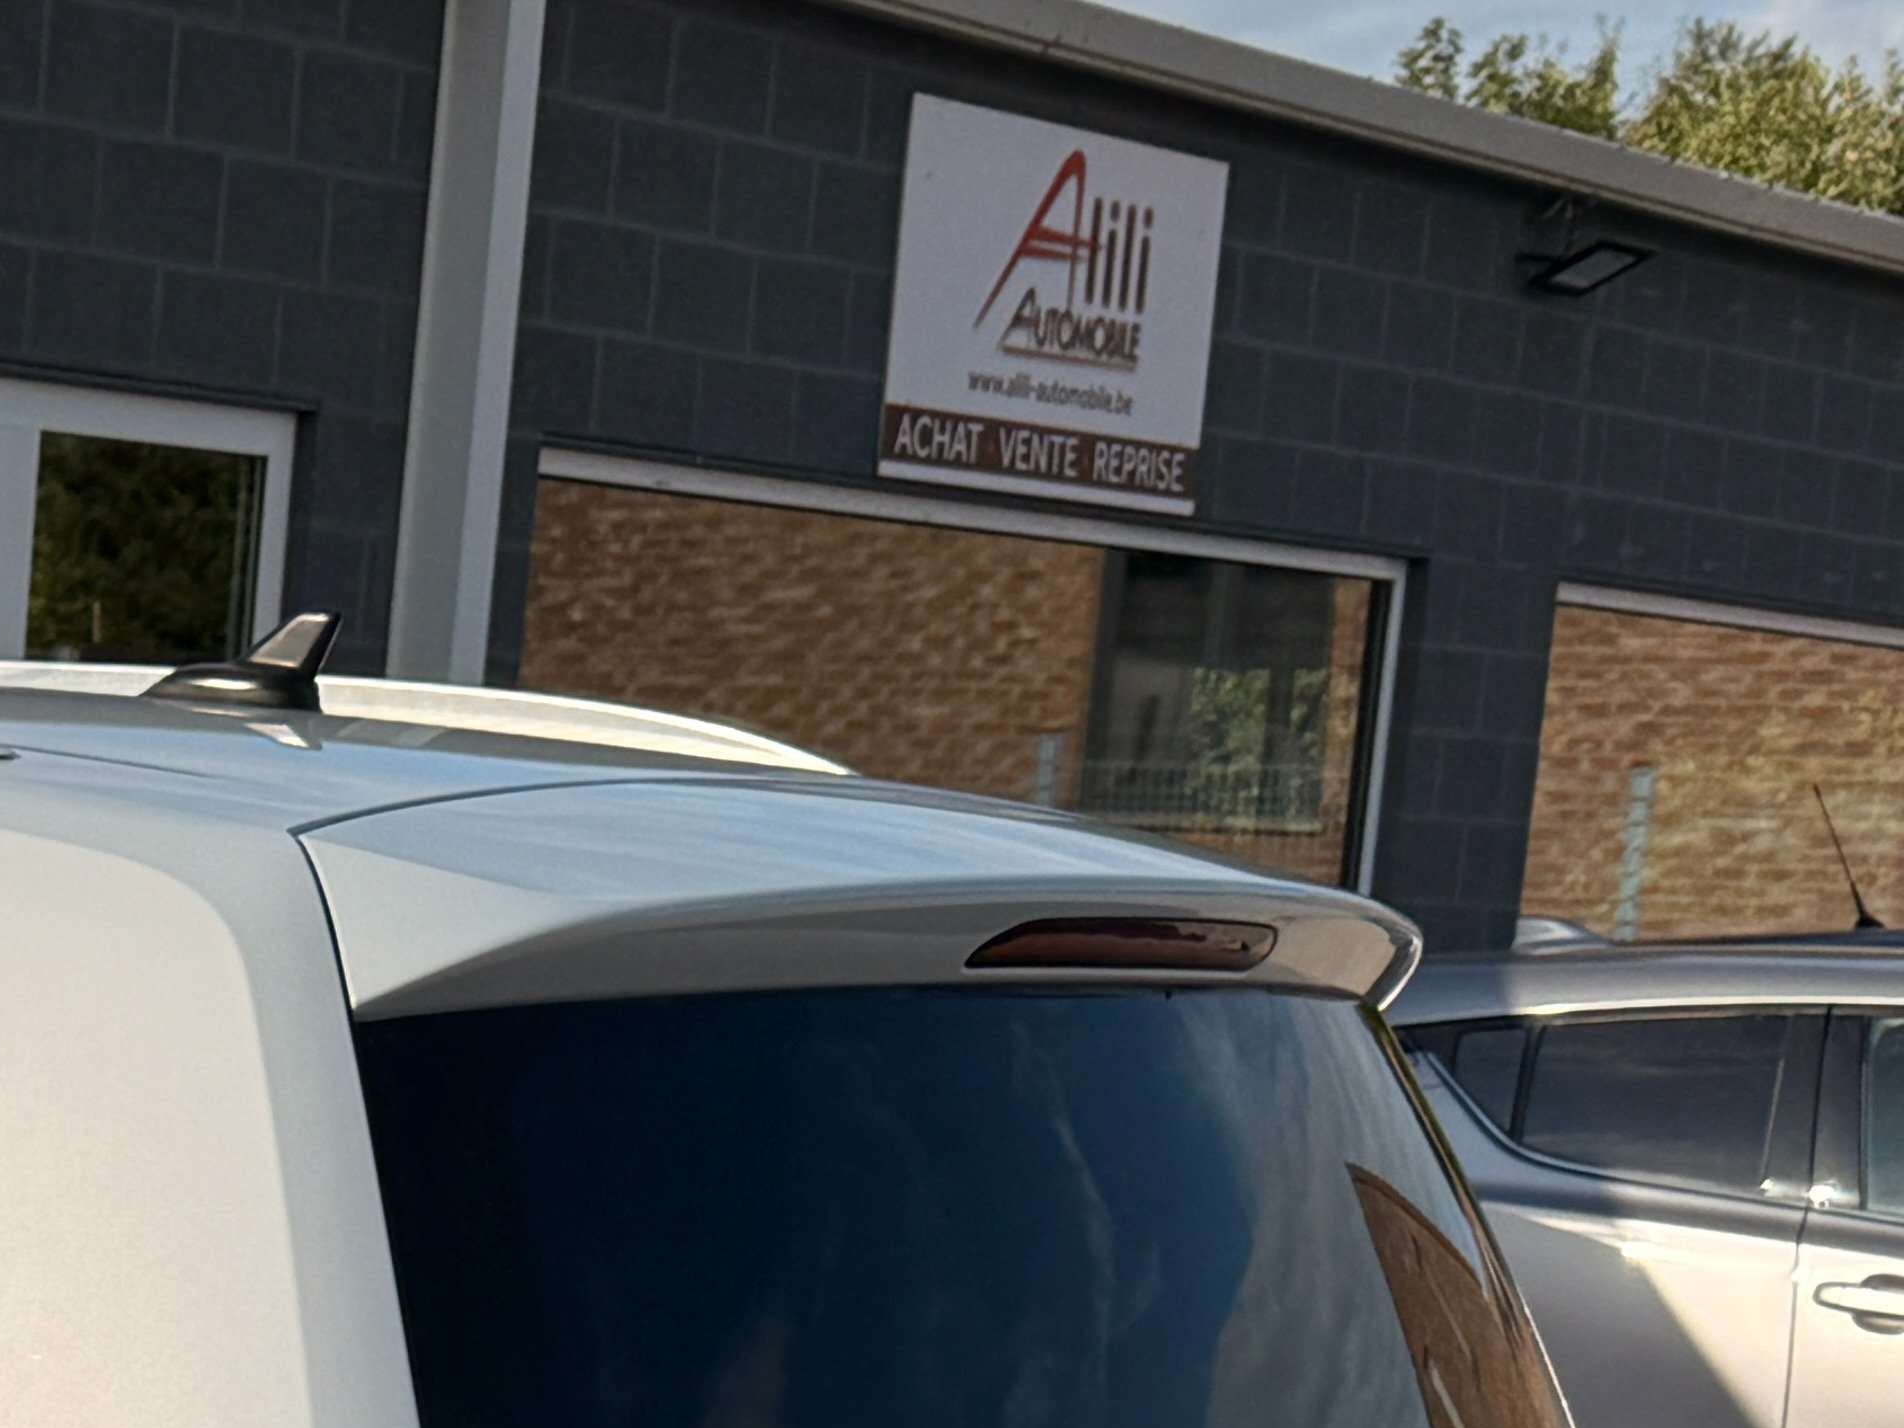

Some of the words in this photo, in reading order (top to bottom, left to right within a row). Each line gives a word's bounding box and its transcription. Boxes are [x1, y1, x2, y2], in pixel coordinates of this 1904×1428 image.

[972, 149, 1155, 332] Alili
[894, 413, 984, 464] ACHAT
[999, 426, 1079, 477] VENTE
[1093, 441, 1185, 493] REPRISE
